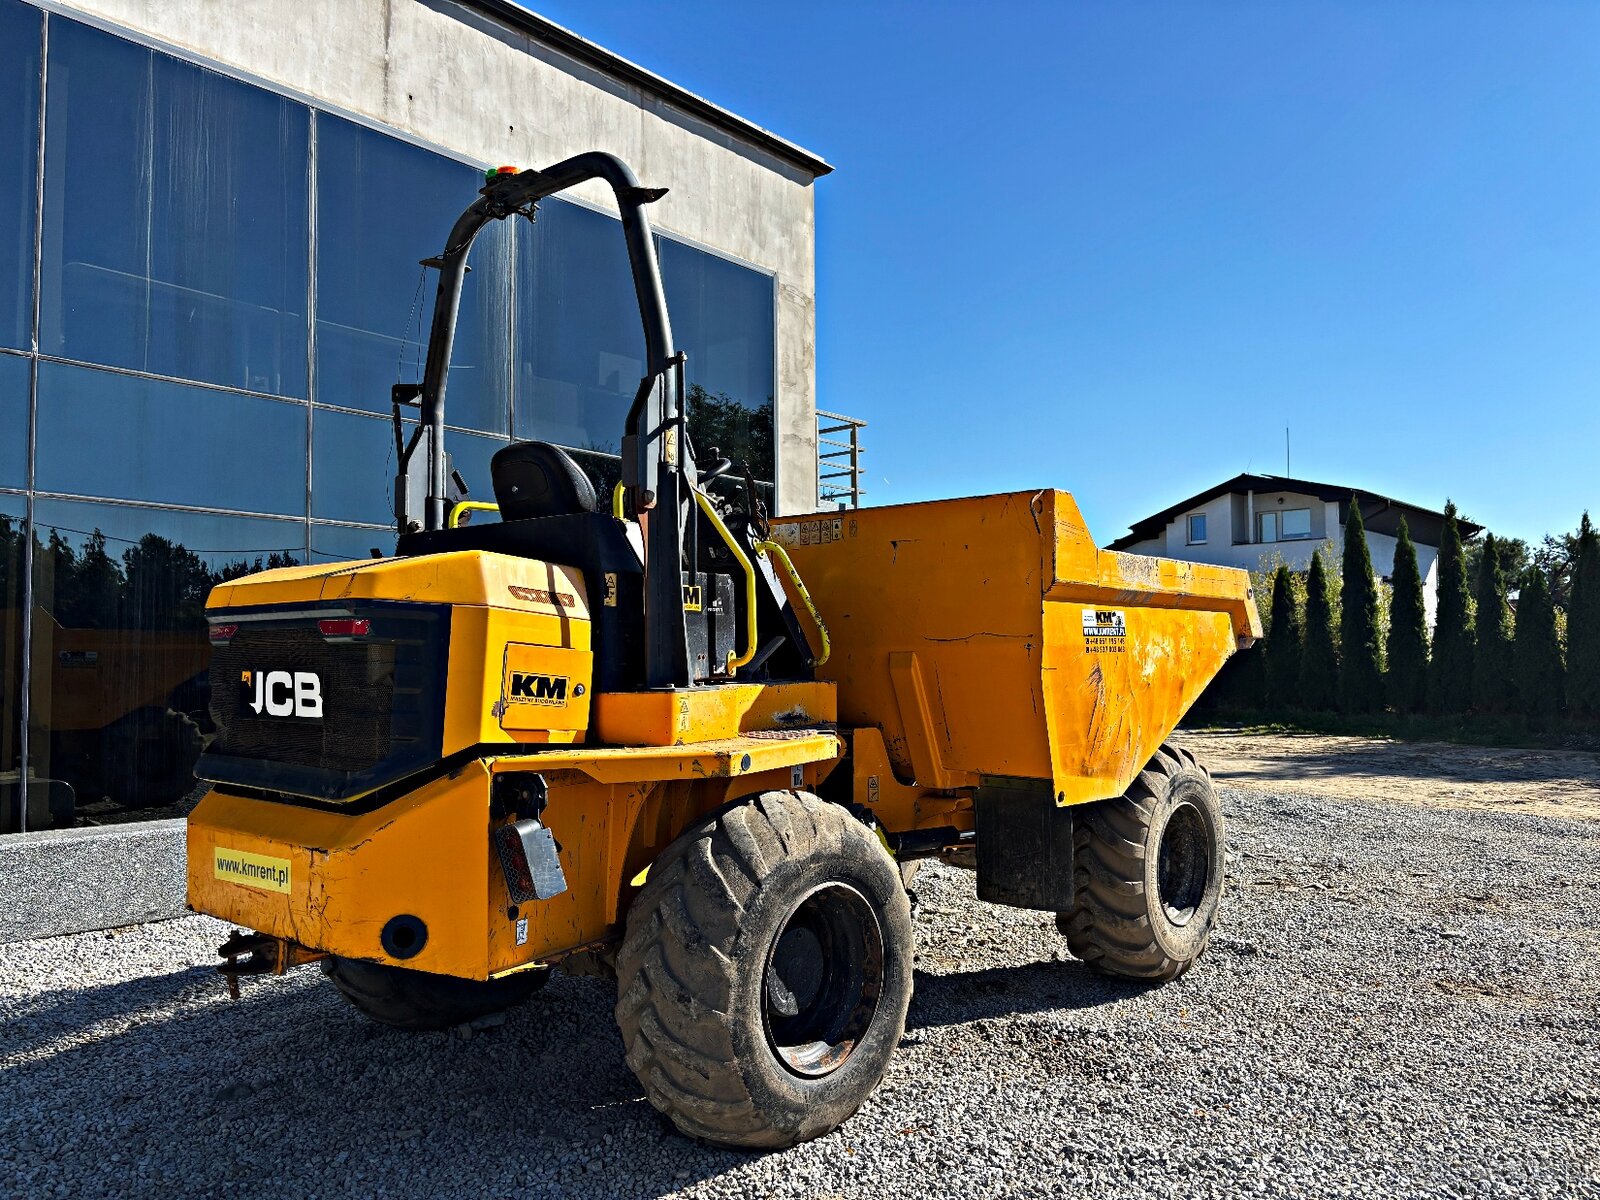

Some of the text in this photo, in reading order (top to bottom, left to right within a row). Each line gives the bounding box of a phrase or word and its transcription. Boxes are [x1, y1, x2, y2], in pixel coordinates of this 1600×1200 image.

[247, 671, 323, 717] JCB
[511, 674, 567, 699] KM
[217, 858, 288, 887] www.kmrent.pl
